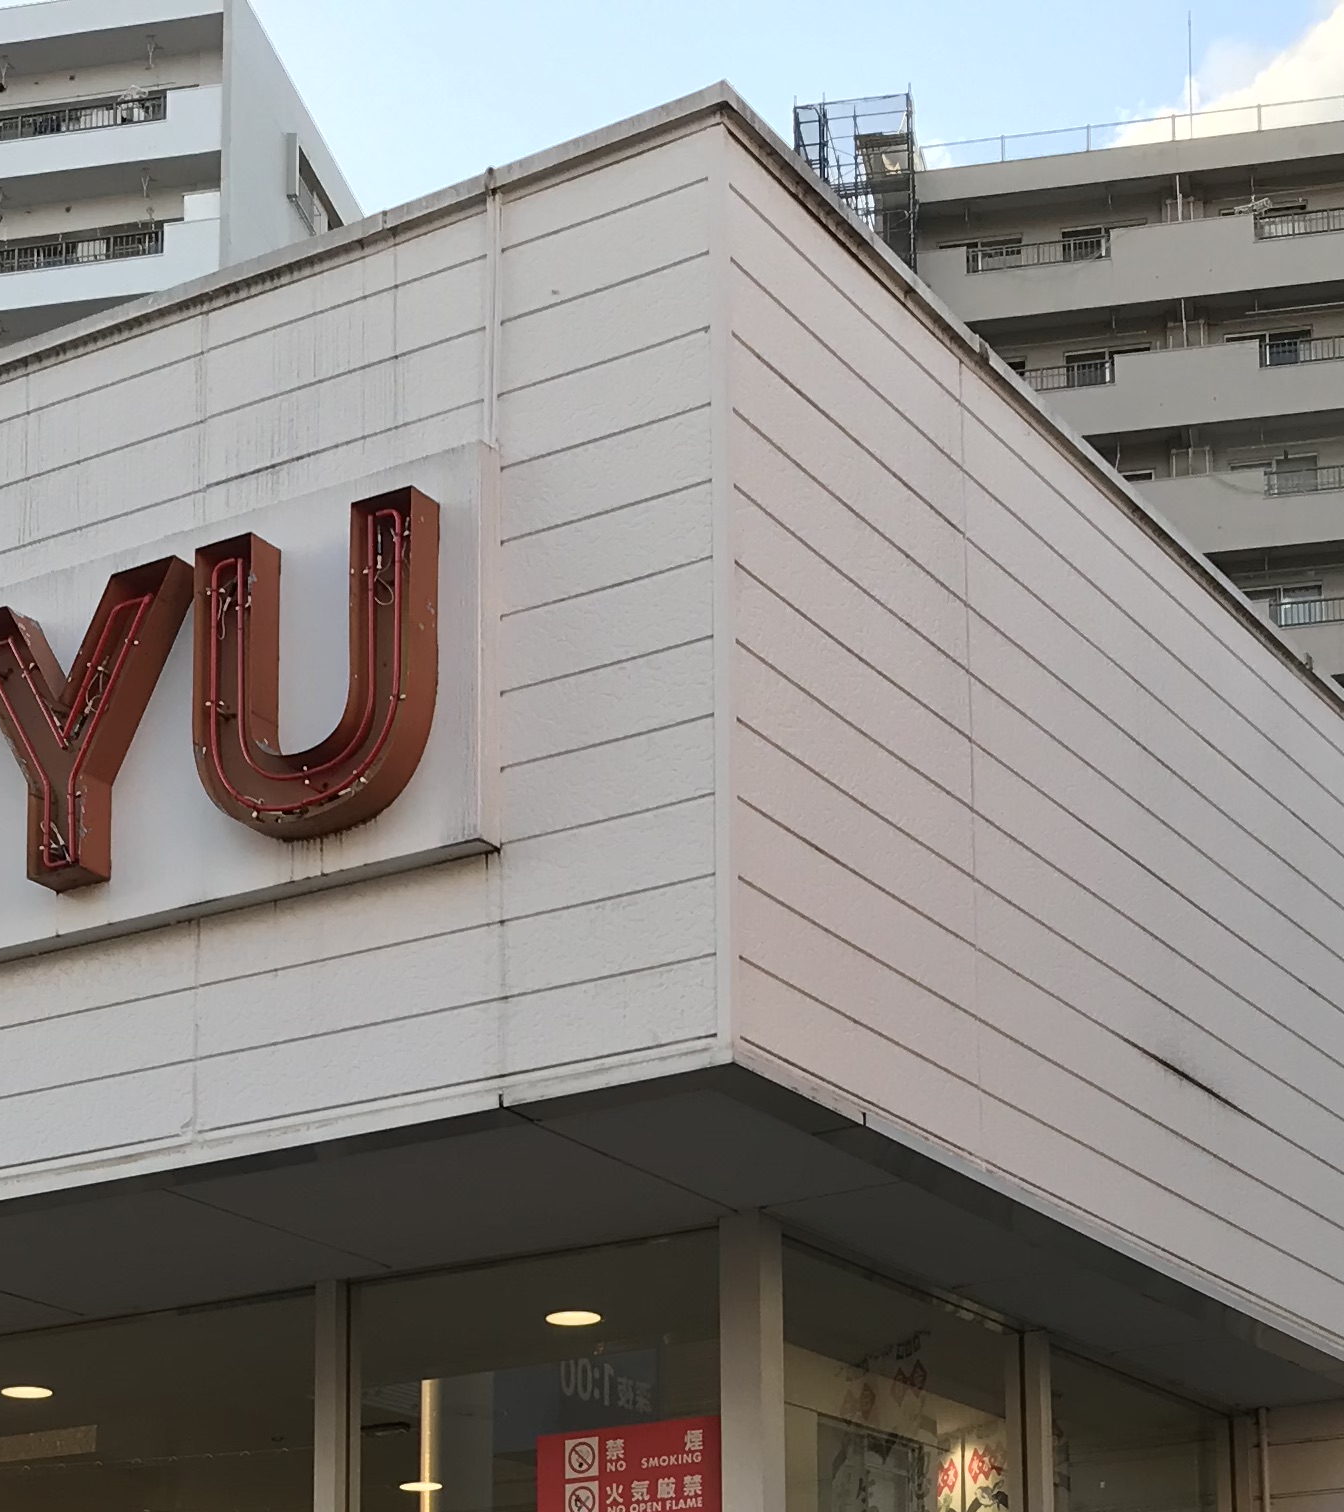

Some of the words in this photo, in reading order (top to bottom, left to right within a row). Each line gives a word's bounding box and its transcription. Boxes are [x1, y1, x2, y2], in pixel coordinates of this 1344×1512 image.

[606, 1461, 626, 1472] NO
[641, 1453, 702, 1468] SMOKING
[606, 1475, 703, 1504] 火気厳禁
[666, 1497, 703, 1511] FLAME
